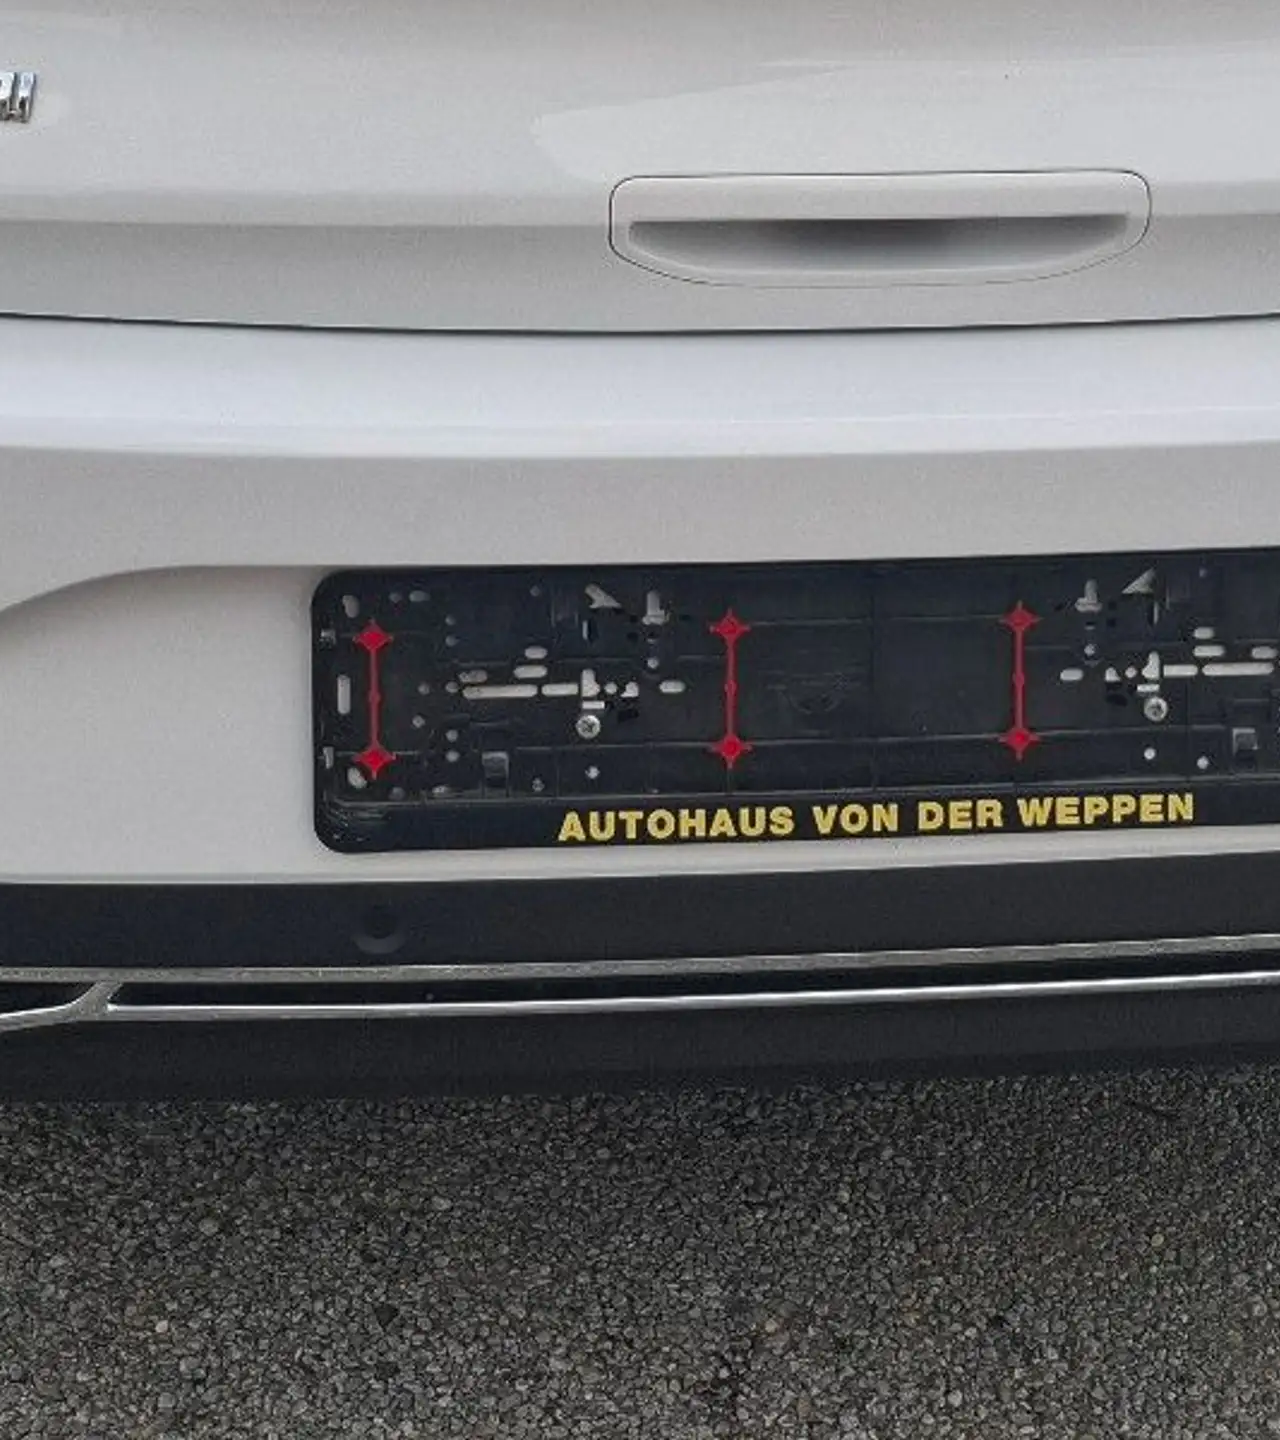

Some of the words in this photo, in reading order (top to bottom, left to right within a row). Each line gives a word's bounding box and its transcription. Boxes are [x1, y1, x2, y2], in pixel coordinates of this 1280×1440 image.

[558, 805, 795, 842] AUTOHAUS
[813, 802, 899, 834] VON
[917, 798, 1004, 830] DER
[1018, 793, 1195, 826] WEPPEN
